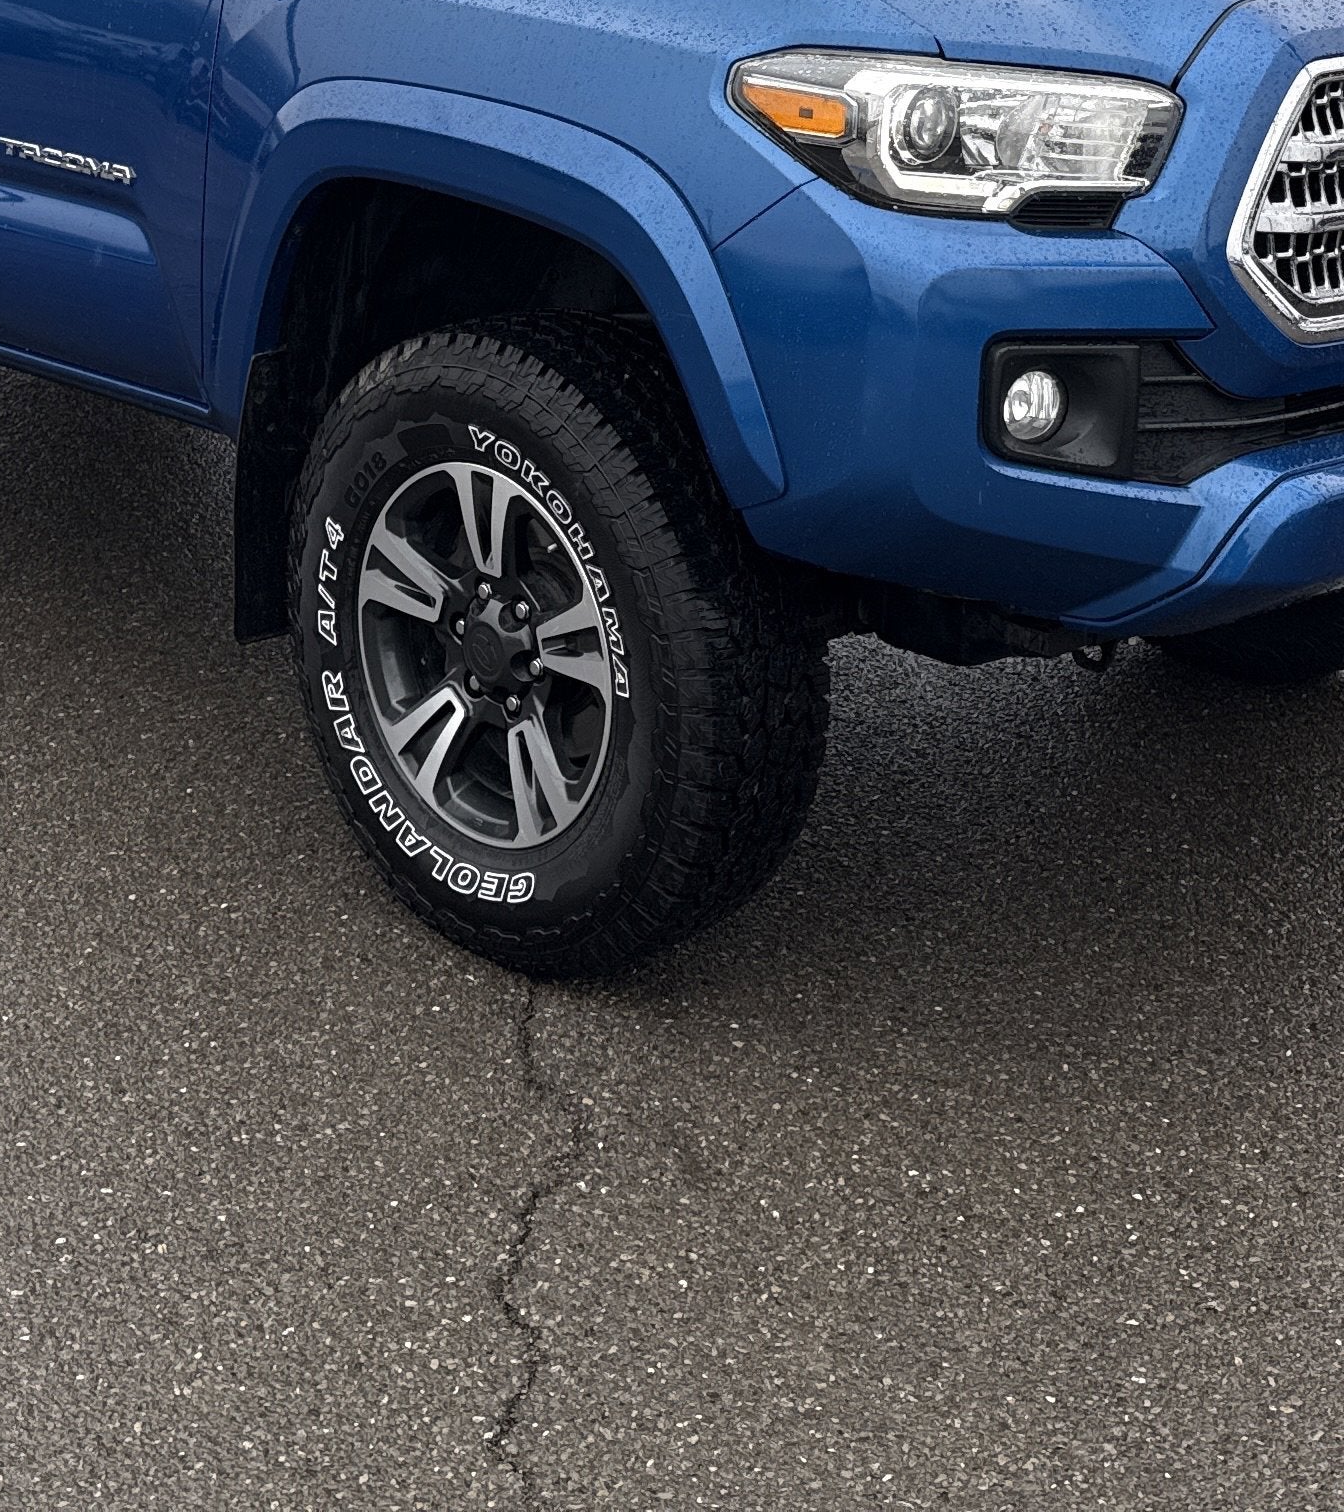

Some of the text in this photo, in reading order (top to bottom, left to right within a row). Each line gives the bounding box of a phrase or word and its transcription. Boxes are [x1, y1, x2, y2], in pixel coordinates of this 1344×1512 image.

[343, 451, 388, 508] G018
[467, 423, 630, 699] YOKOHAMA
[321, 669, 535, 904] GEOLANDAR
